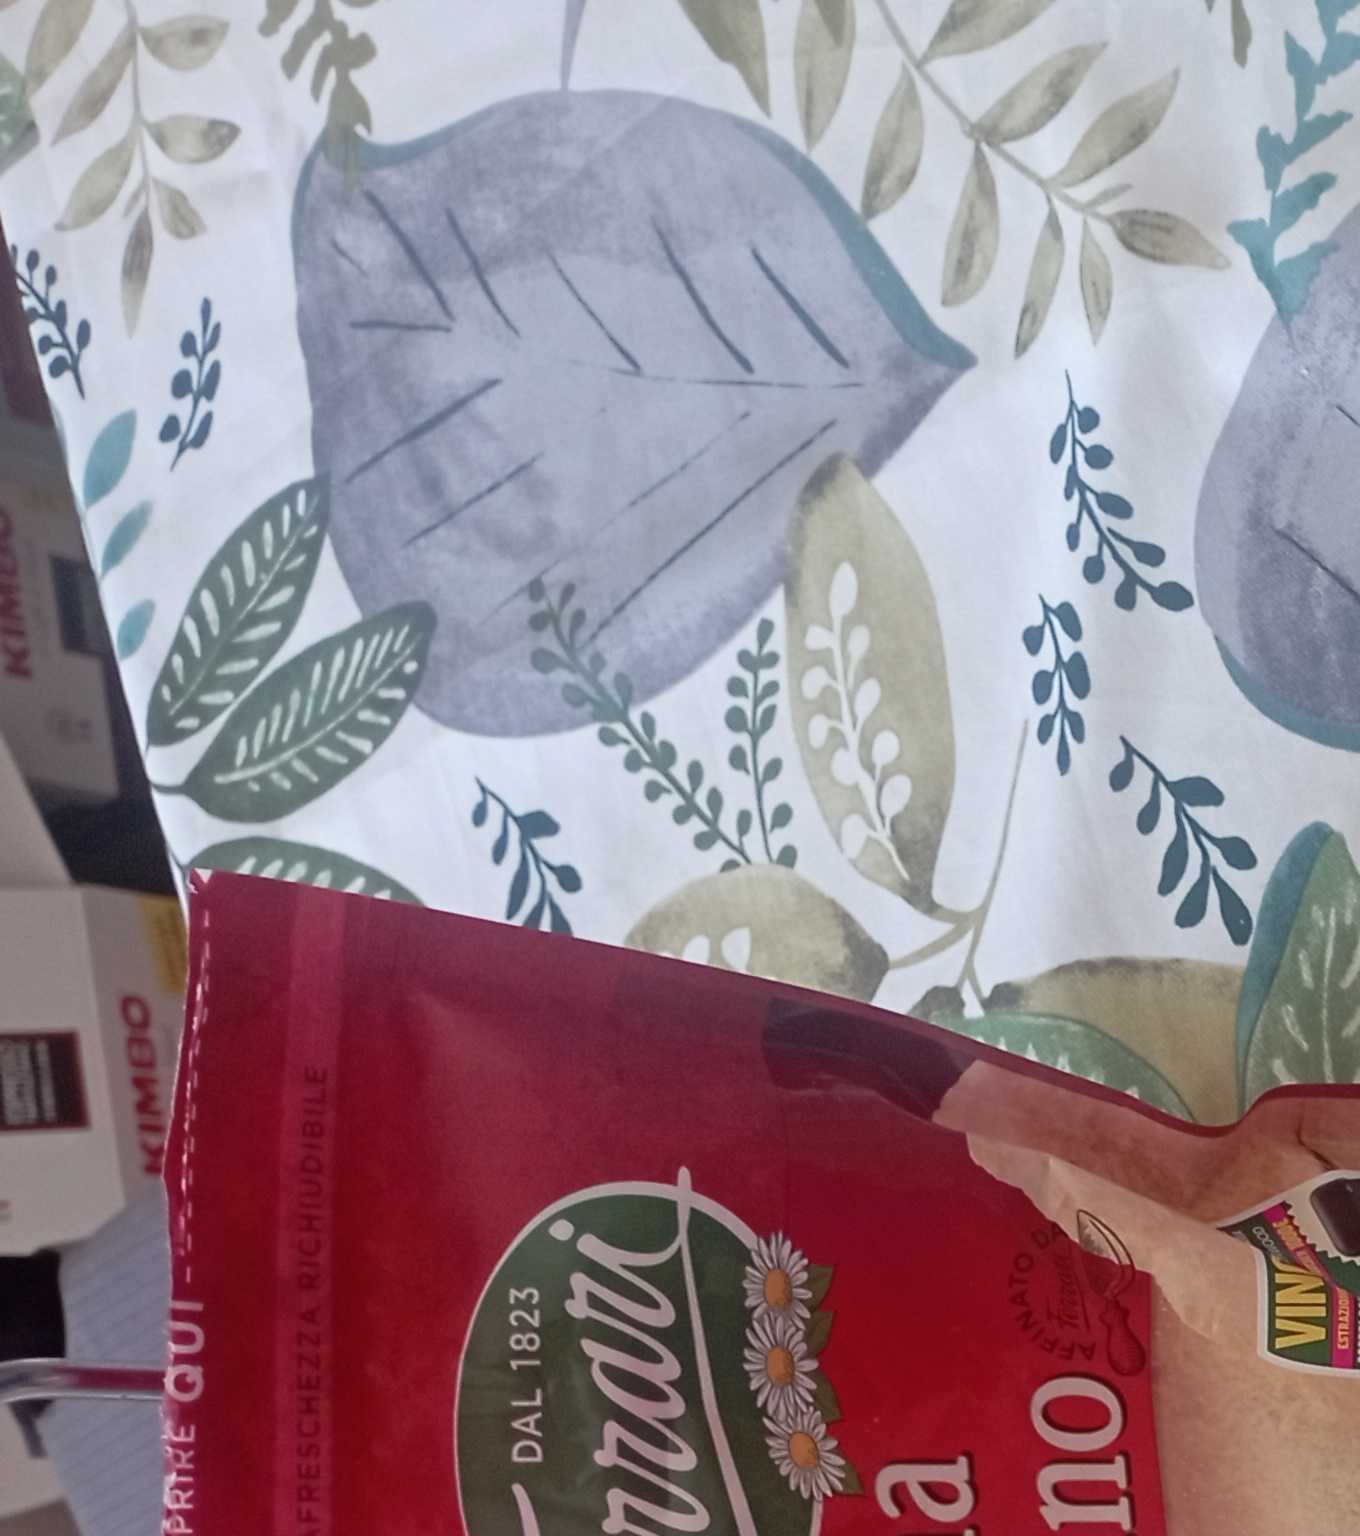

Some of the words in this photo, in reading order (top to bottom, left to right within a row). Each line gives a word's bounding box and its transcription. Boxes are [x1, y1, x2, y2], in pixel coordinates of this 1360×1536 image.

[119, 993, 165, 1175] KIMBO
[296, 1063, 327, 1290] RICHIUDIBILE
[164, 1299, 205, 1401] QUI
[508, 1284, 542, 1370] 1823
[1008, 1251, 1097, 1360] AFFINATO
[510, 1386, 544, 1463] DAL
